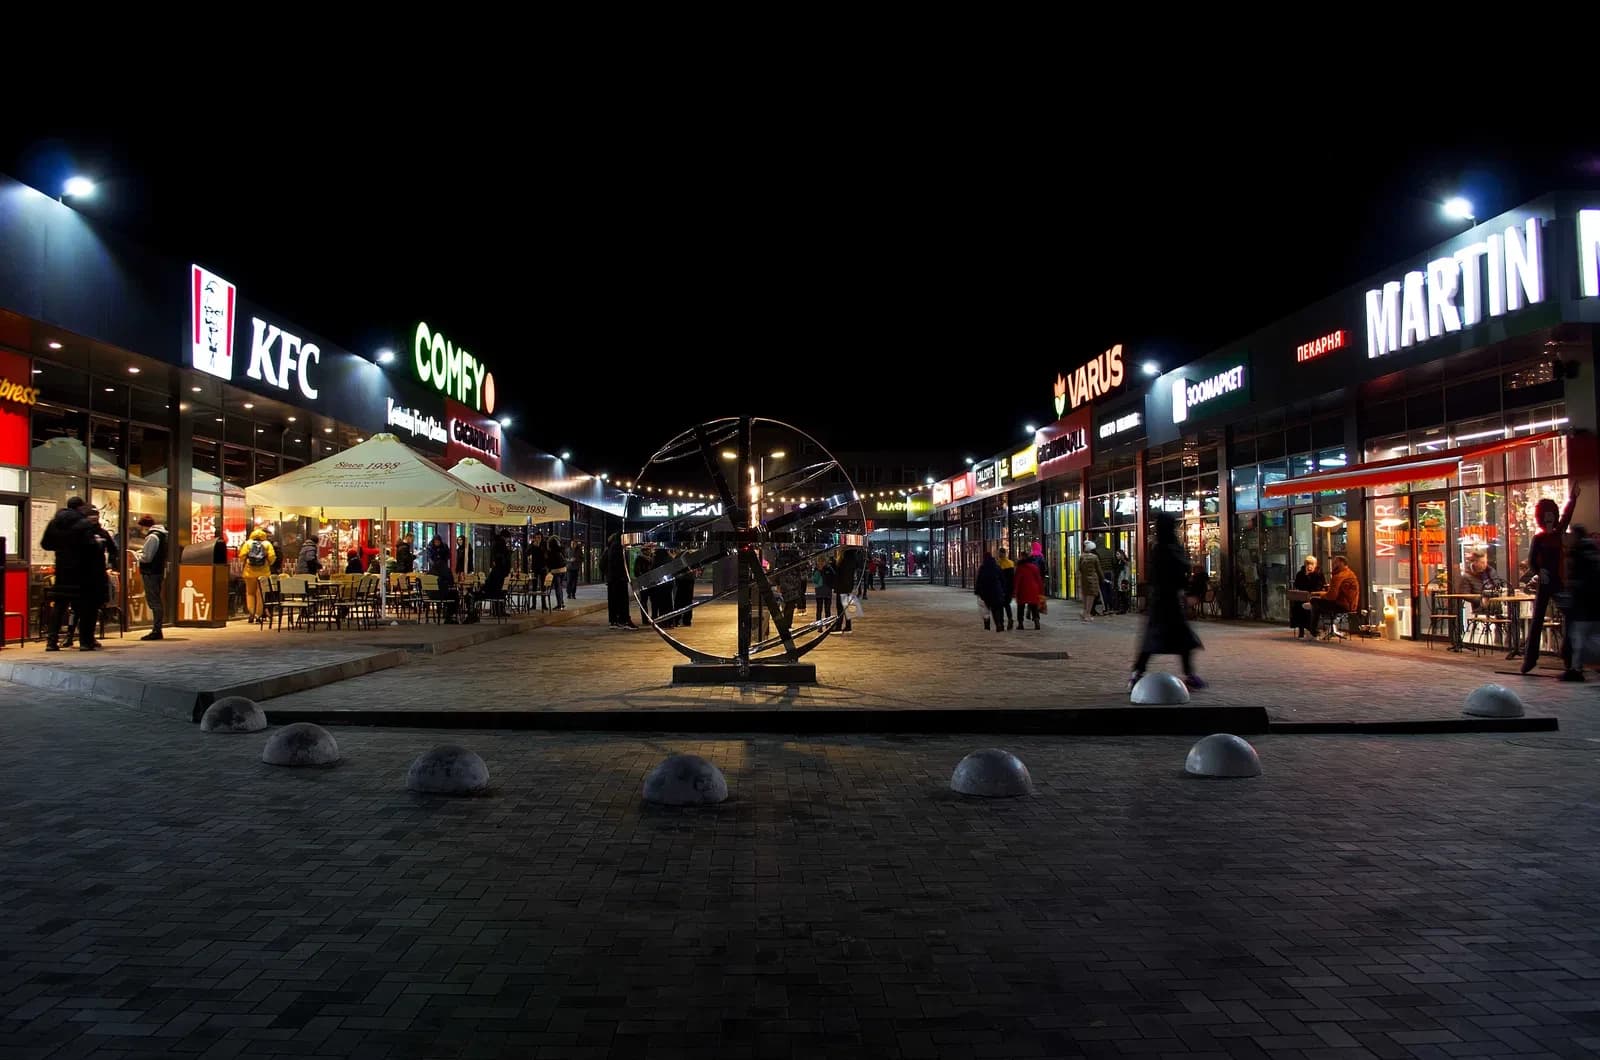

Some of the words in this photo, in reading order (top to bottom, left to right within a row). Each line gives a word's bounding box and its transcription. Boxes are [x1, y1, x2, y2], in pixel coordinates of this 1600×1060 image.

[1365, 217, 1544, 359] MARTIN
[247, 316, 320, 400] KFC
[415, 322, 484, 411] COMFY
[1297, 330, 1342, 362] ПЕКАРНЯ
[0, 378, 40, 406] press
[1067, 344, 1124, 408] VARUS
[366, 461, 401, 470] 1988
[526, 505, 547, 514] 1988
